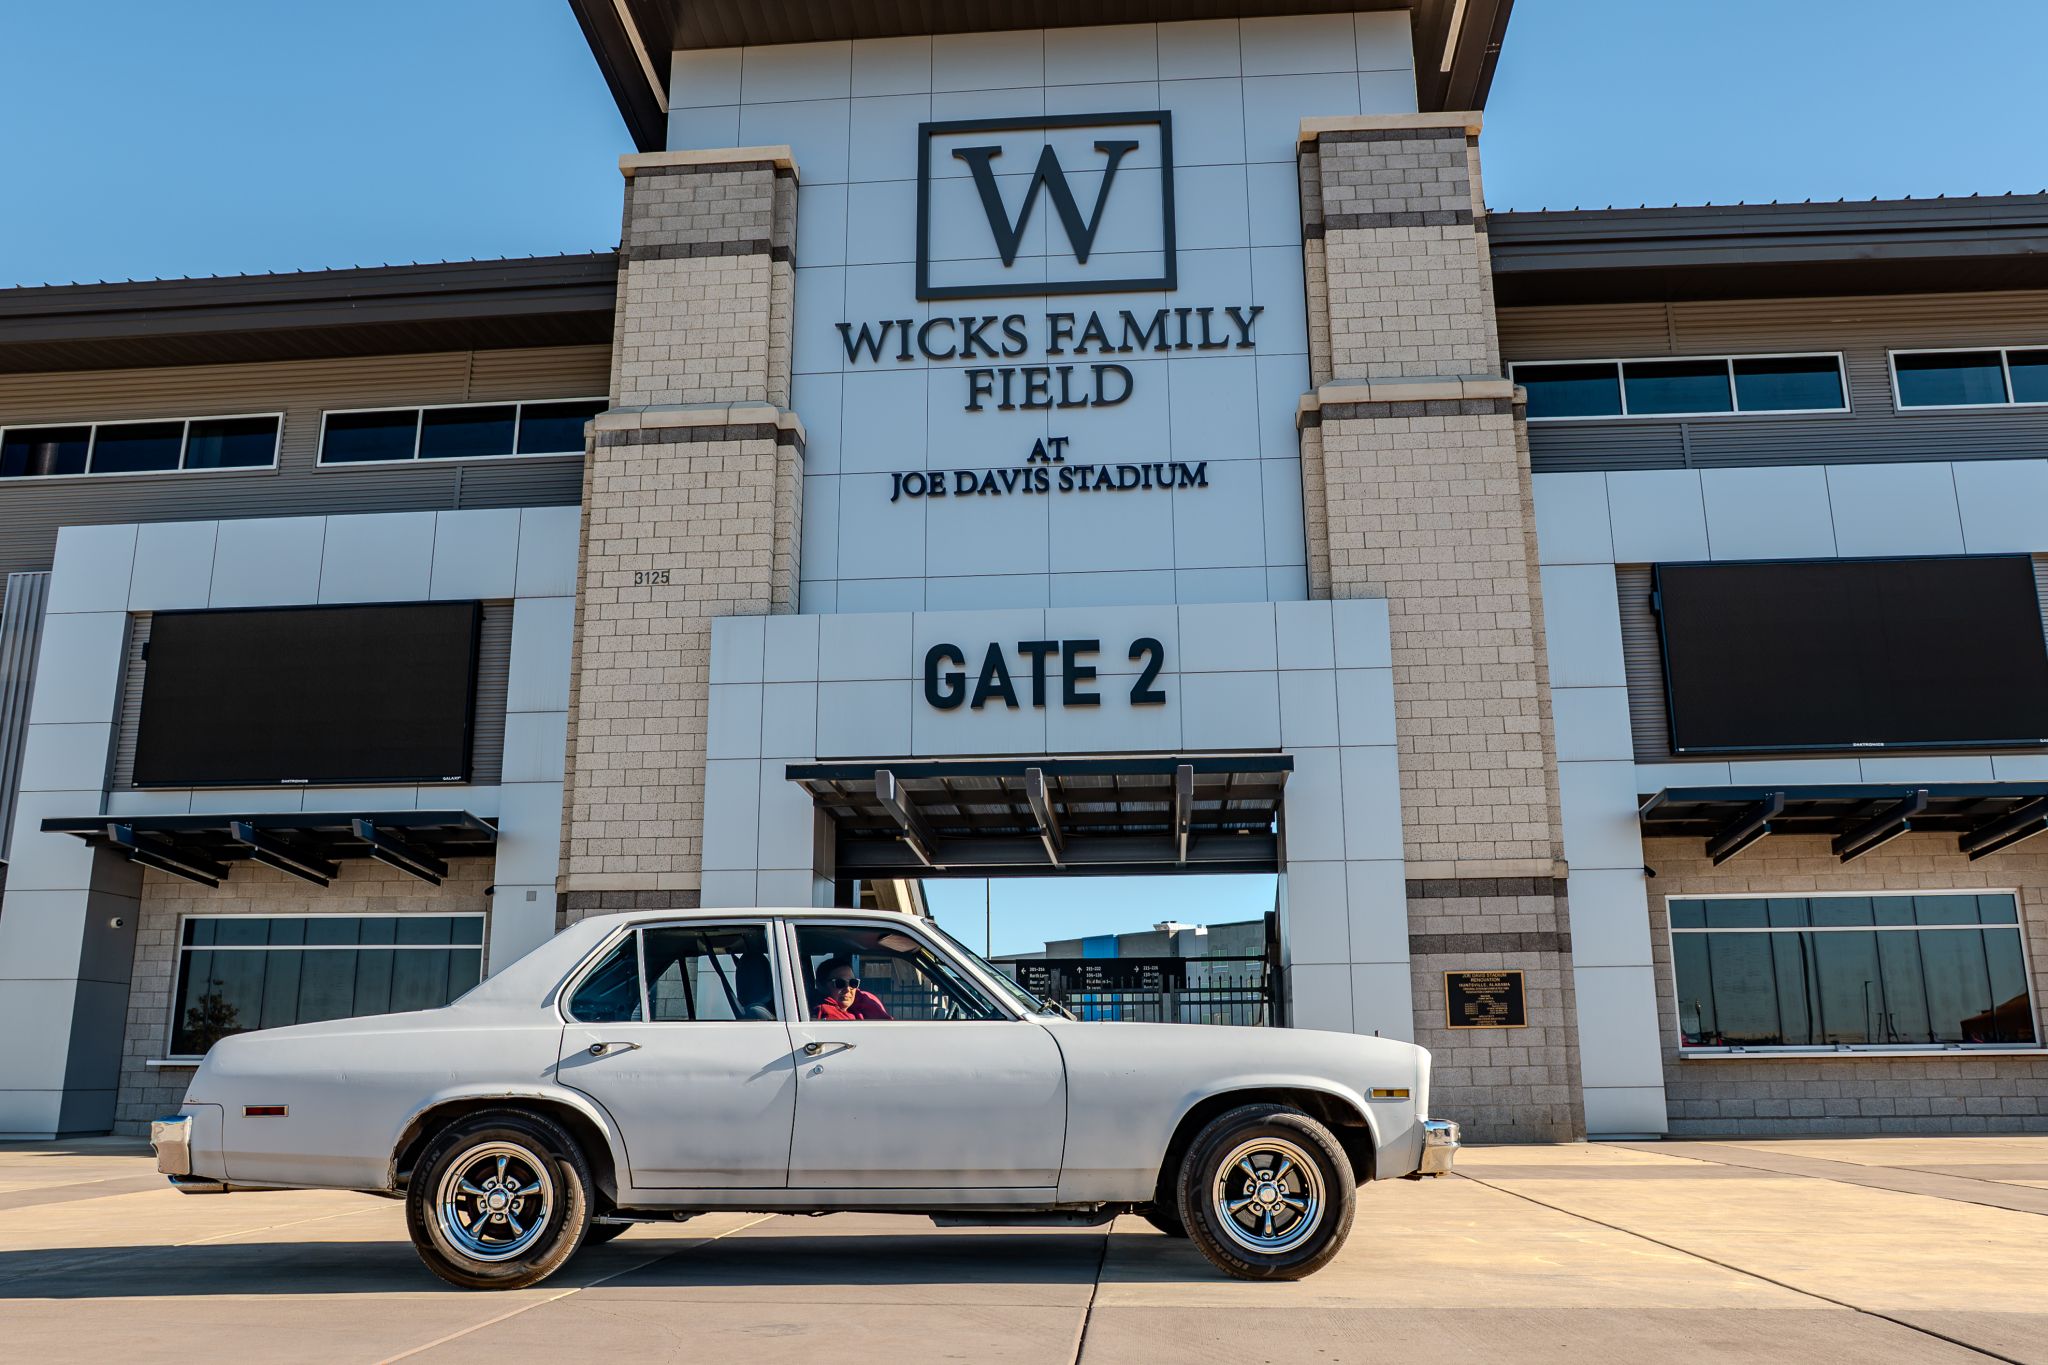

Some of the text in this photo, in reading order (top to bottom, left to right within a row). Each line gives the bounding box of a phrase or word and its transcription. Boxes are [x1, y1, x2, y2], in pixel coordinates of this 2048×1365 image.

[952, 140, 1139, 267] W
[835, 306, 1264, 363] WICKS FAMILY
[964, 364, 1134, 412] FIELD
[1026, 436, 1069, 462] AT
[890, 461, 1209, 502] JOE DAVIS STADIUM
[635, 571, 670, 585] 3125
[924, 637, 1166, 709] GATE 2
